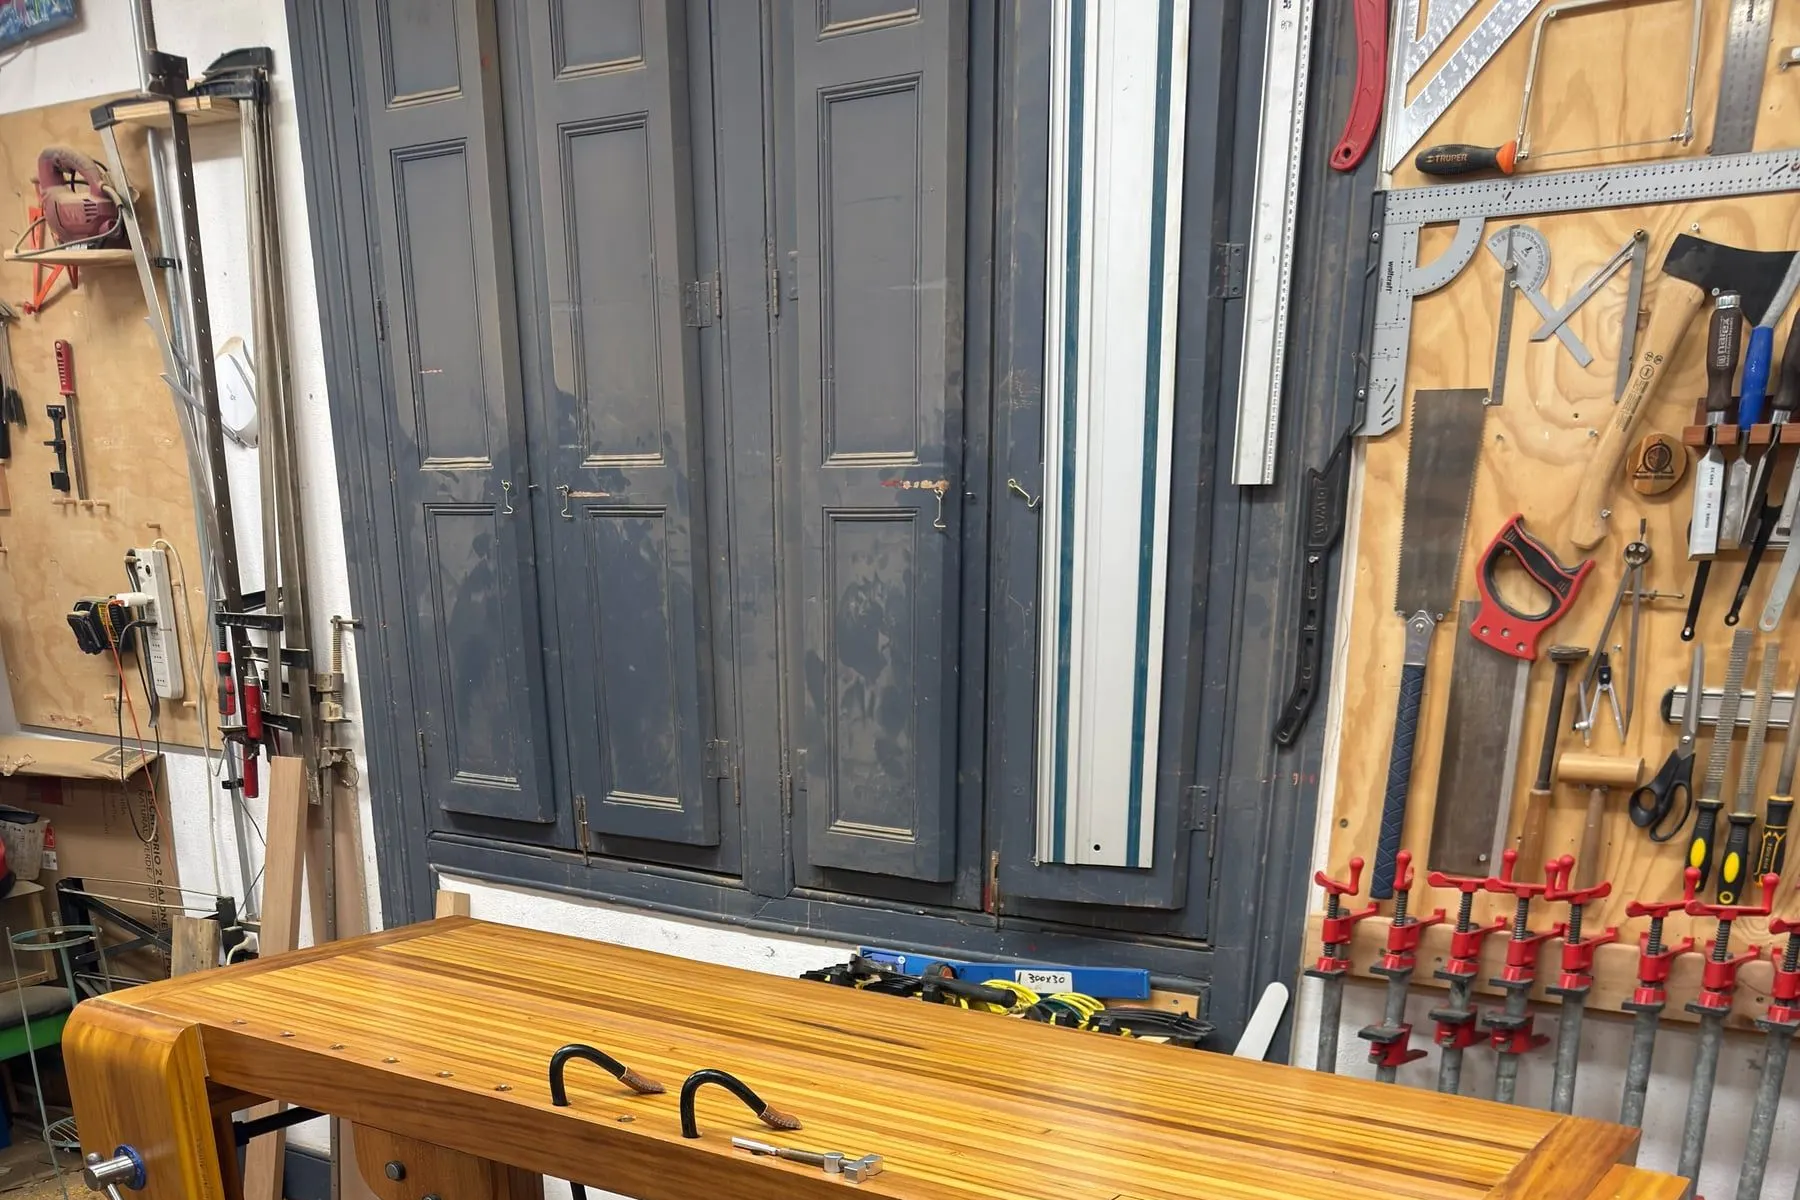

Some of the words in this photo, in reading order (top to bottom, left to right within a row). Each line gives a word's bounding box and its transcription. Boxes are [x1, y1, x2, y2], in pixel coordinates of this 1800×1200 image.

[1435, 153, 1468, 163] TRUPER
[1385, 261, 1394, 292] wolfcraft
[1718, 317, 1730, 354] narex
[157, 880, 168, 932] CAJONE
